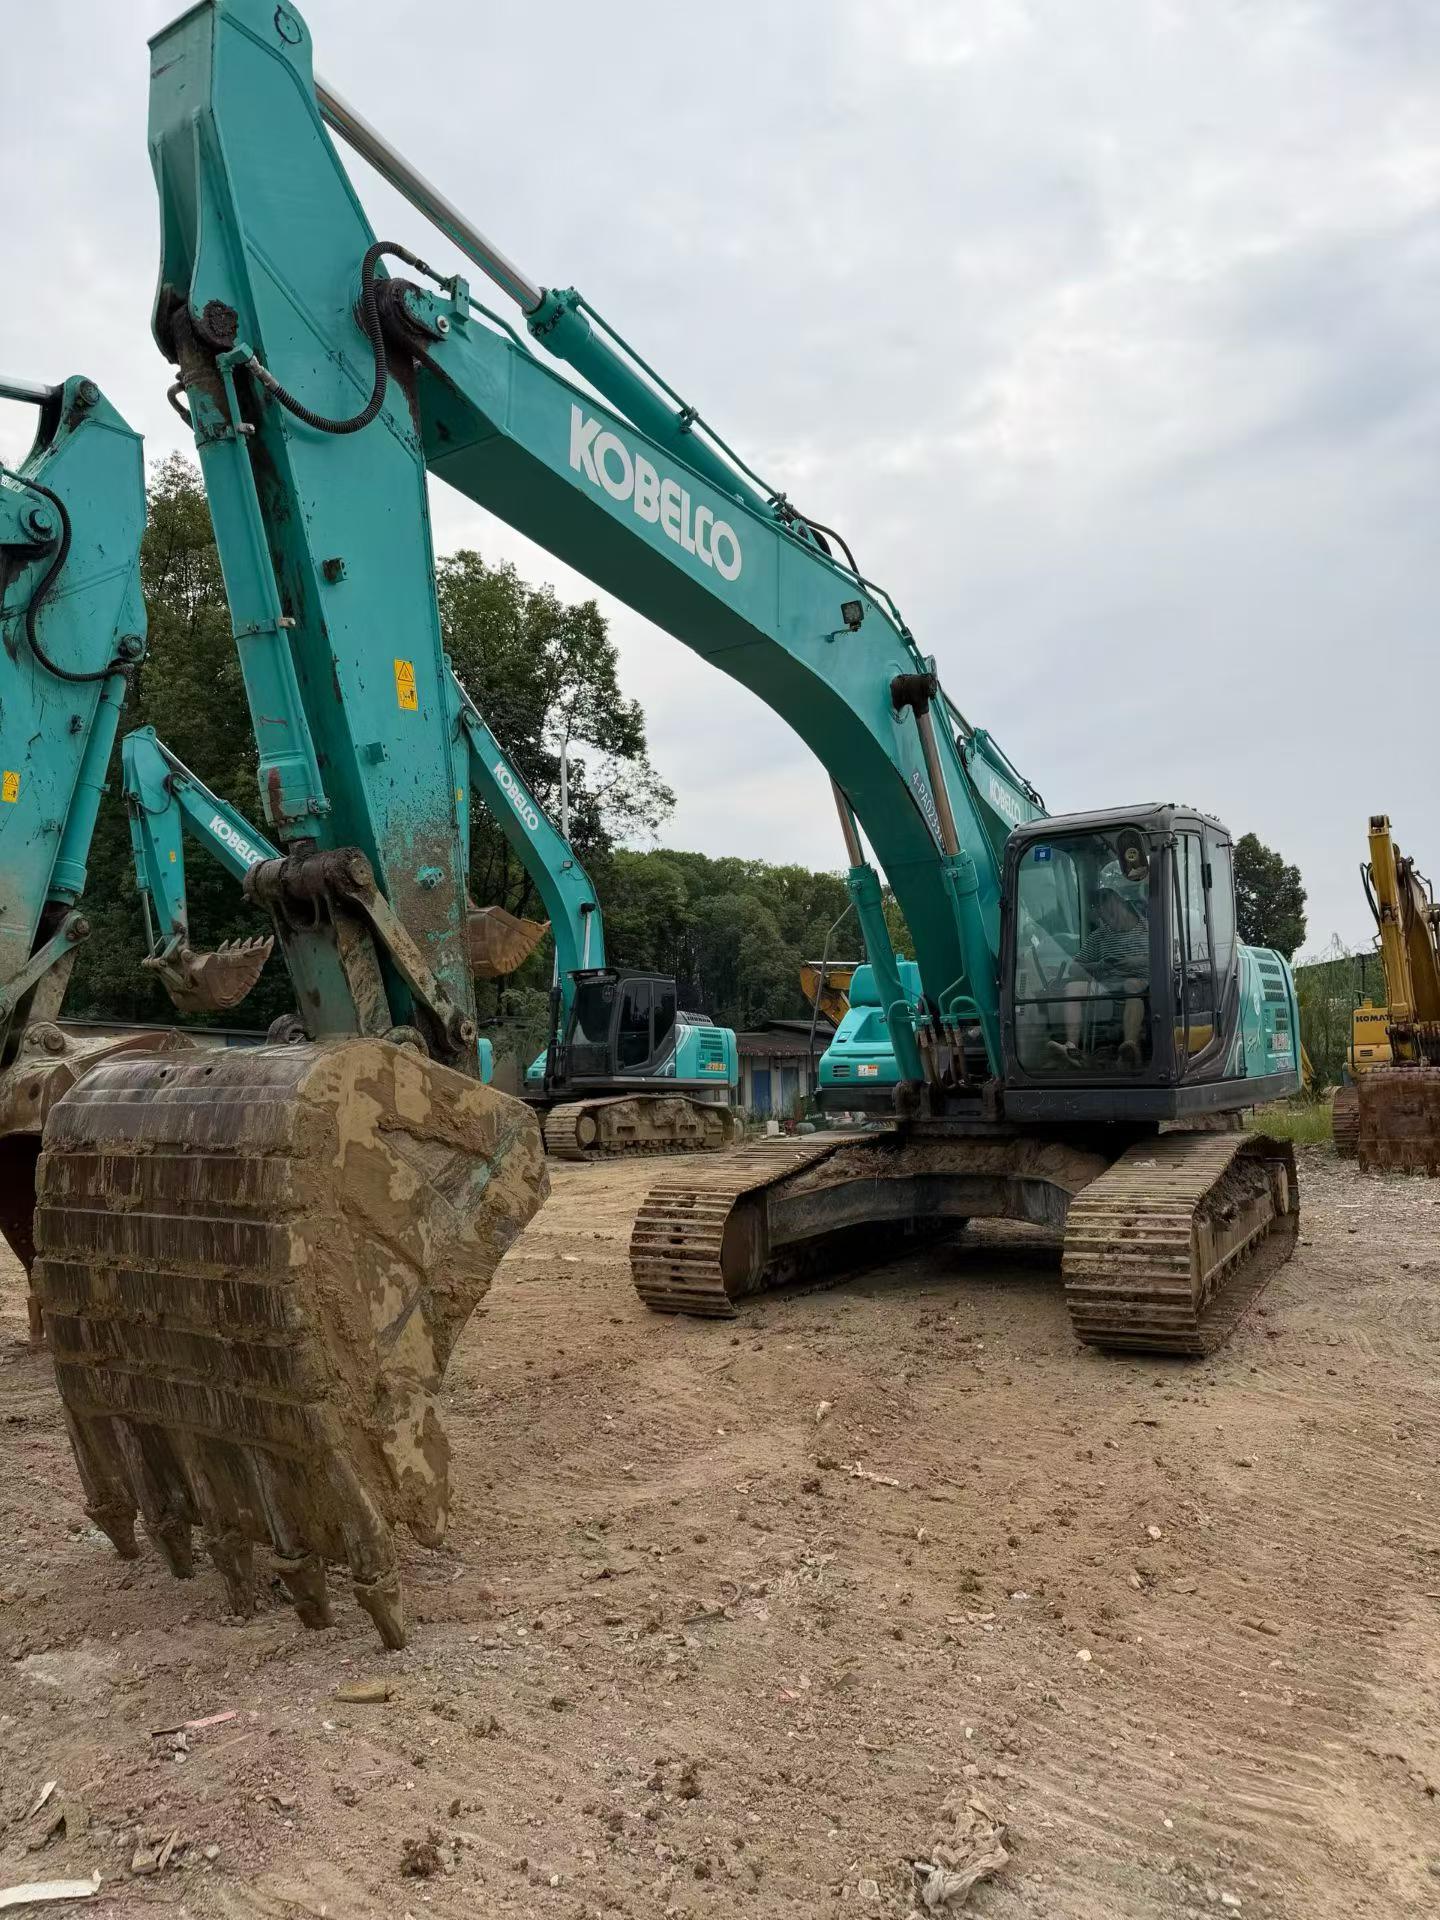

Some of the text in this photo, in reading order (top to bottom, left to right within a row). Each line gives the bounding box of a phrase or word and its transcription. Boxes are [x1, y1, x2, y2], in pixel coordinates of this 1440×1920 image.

[569, 402, 742, 581] KOBELCO
[493, 760, 538, 830] KOBELCO
[990, 777, 1021, 825] KOBELCO
[1356, 1014, 1390, 1022] KOMAT
